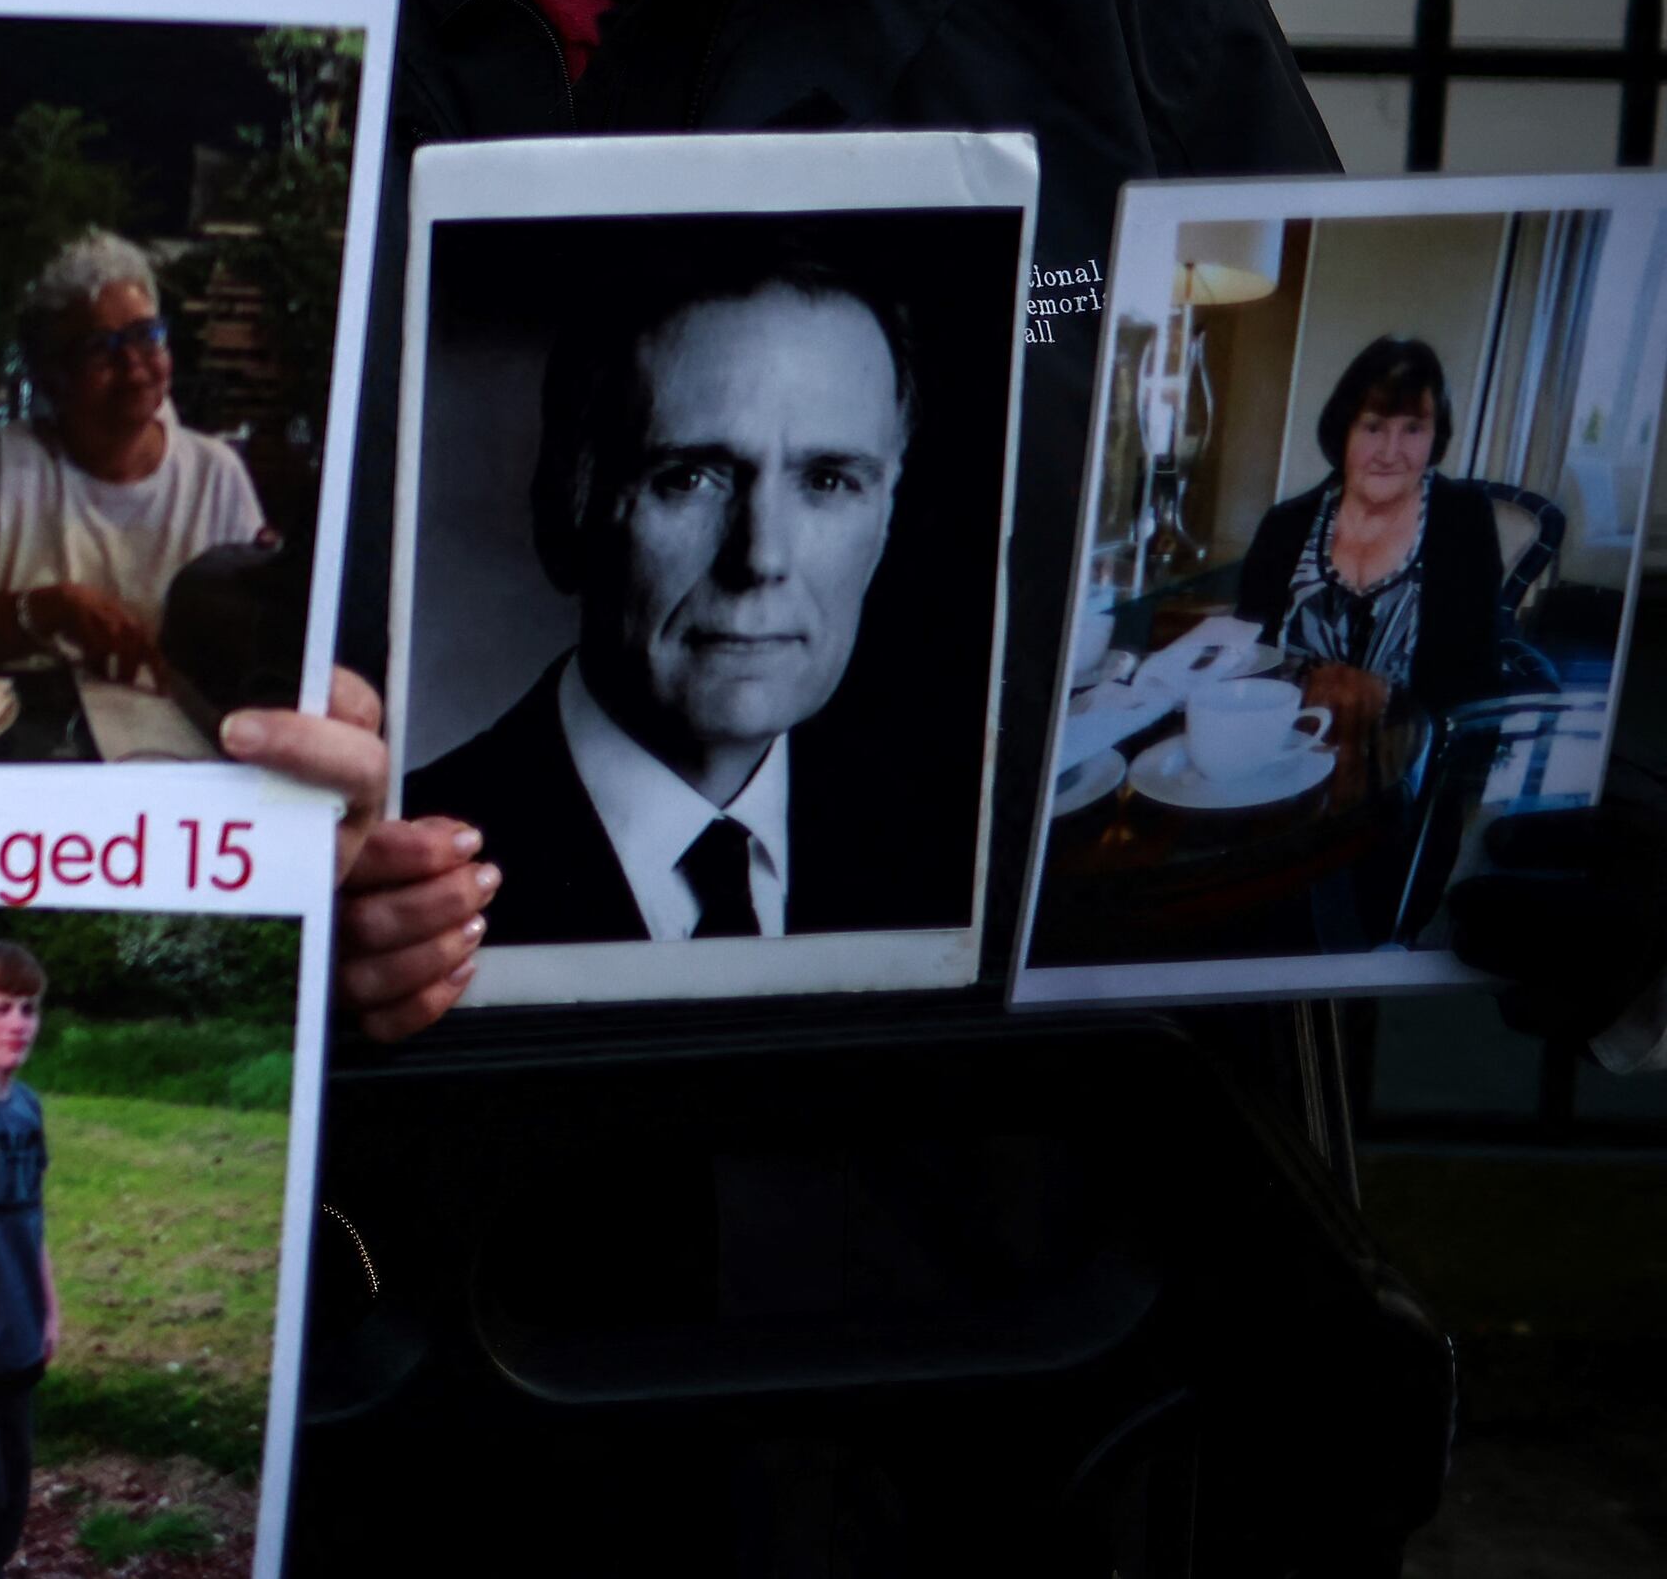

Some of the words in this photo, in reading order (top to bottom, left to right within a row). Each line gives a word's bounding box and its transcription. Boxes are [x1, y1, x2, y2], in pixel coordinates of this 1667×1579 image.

[1026, 287, 1107, 315] emori
[1023, 319, 1056, 344] all
[177, 818, 256, 892] 15
